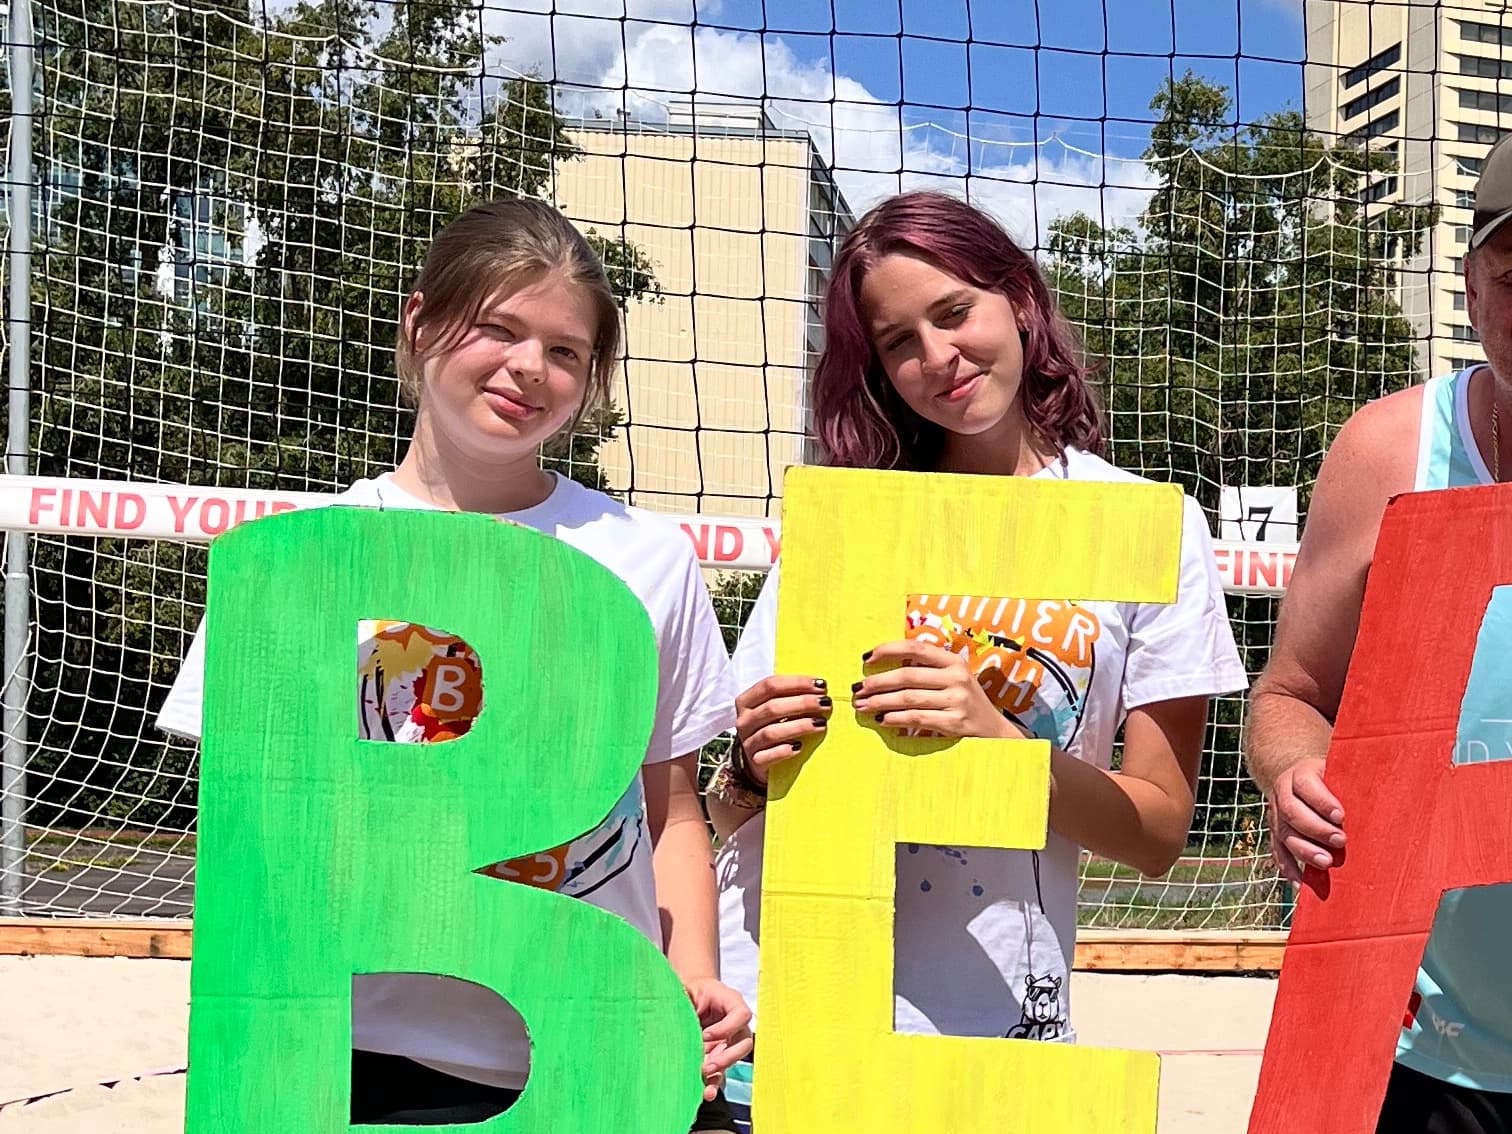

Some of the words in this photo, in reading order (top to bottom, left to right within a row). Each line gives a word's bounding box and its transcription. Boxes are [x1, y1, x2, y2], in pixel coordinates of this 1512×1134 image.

[28, 487, 146, 530] FIND
[1248, 506, 1274, 541] 7
[680, 523, 744, 561] ND
